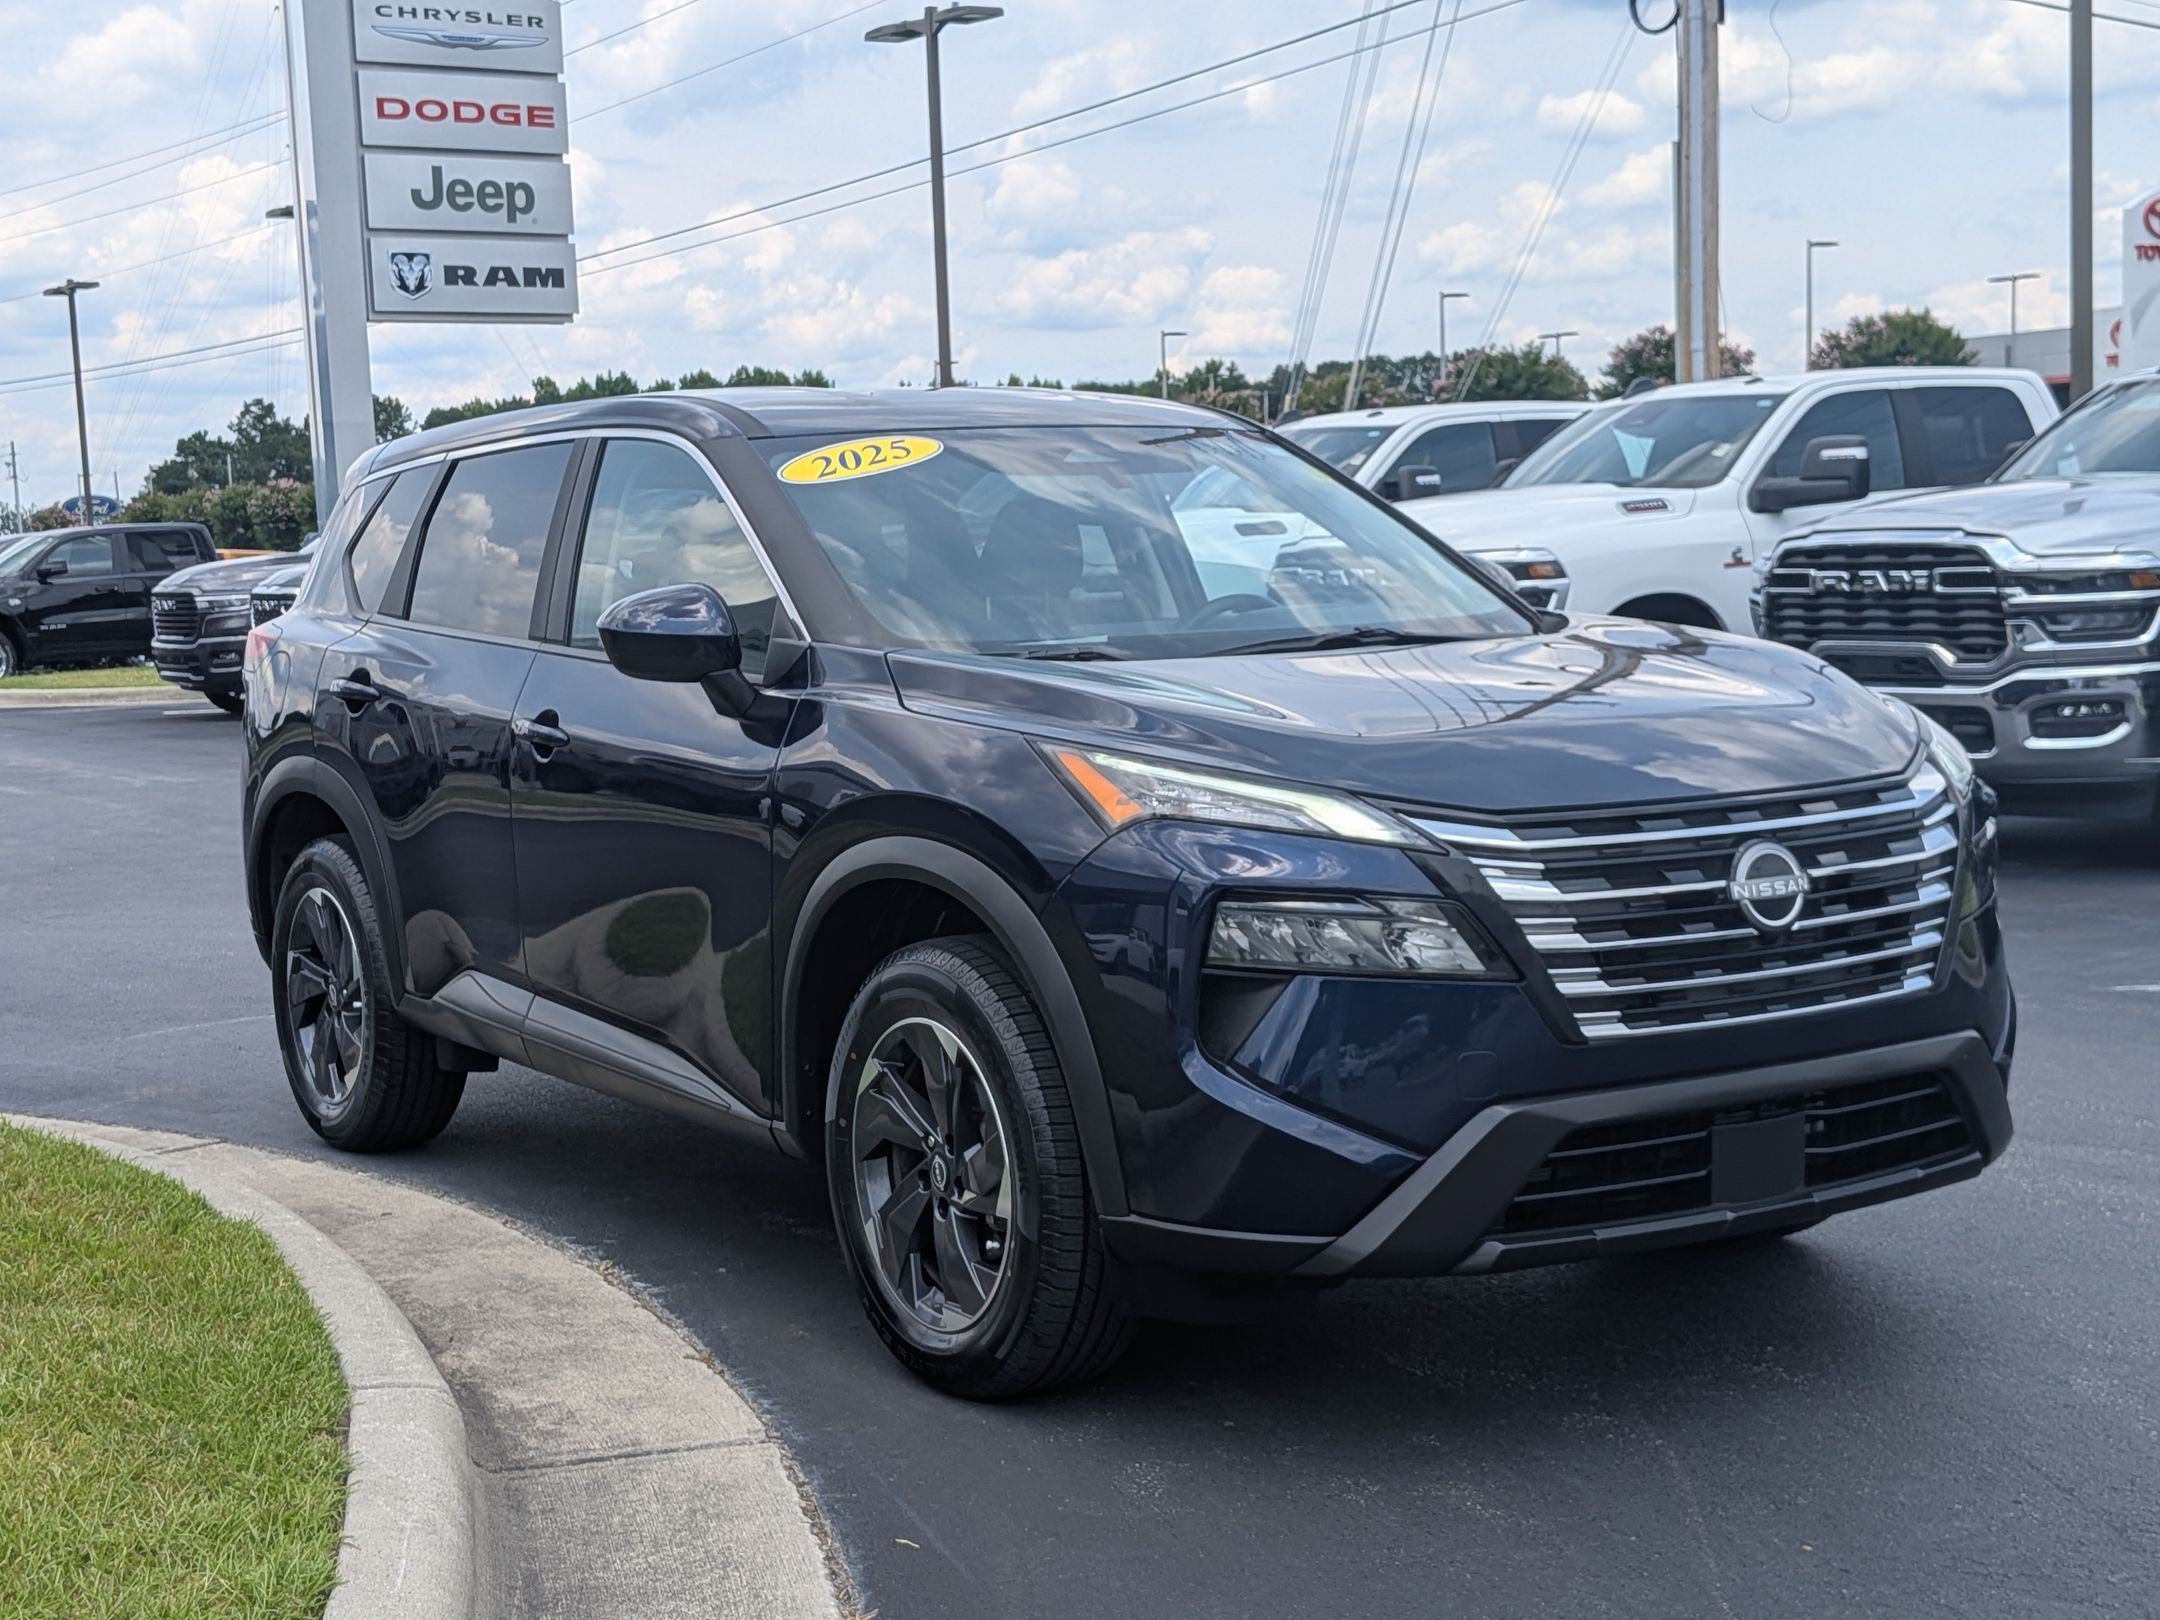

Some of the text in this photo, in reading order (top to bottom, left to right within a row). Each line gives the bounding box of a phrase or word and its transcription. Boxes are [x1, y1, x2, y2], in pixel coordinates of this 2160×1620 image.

[375, 5, 544, 28] CHRYSLER
[376, 97, 555, 128] DODGE
[410, 165, 535, 223] Jeep
[443, 264, 565, 288] RAM
[812, 440, 911, 479] 2025
[1813, 569, 1930, 593] RAM
[1733, 878, 1808, 899] NISSAN
